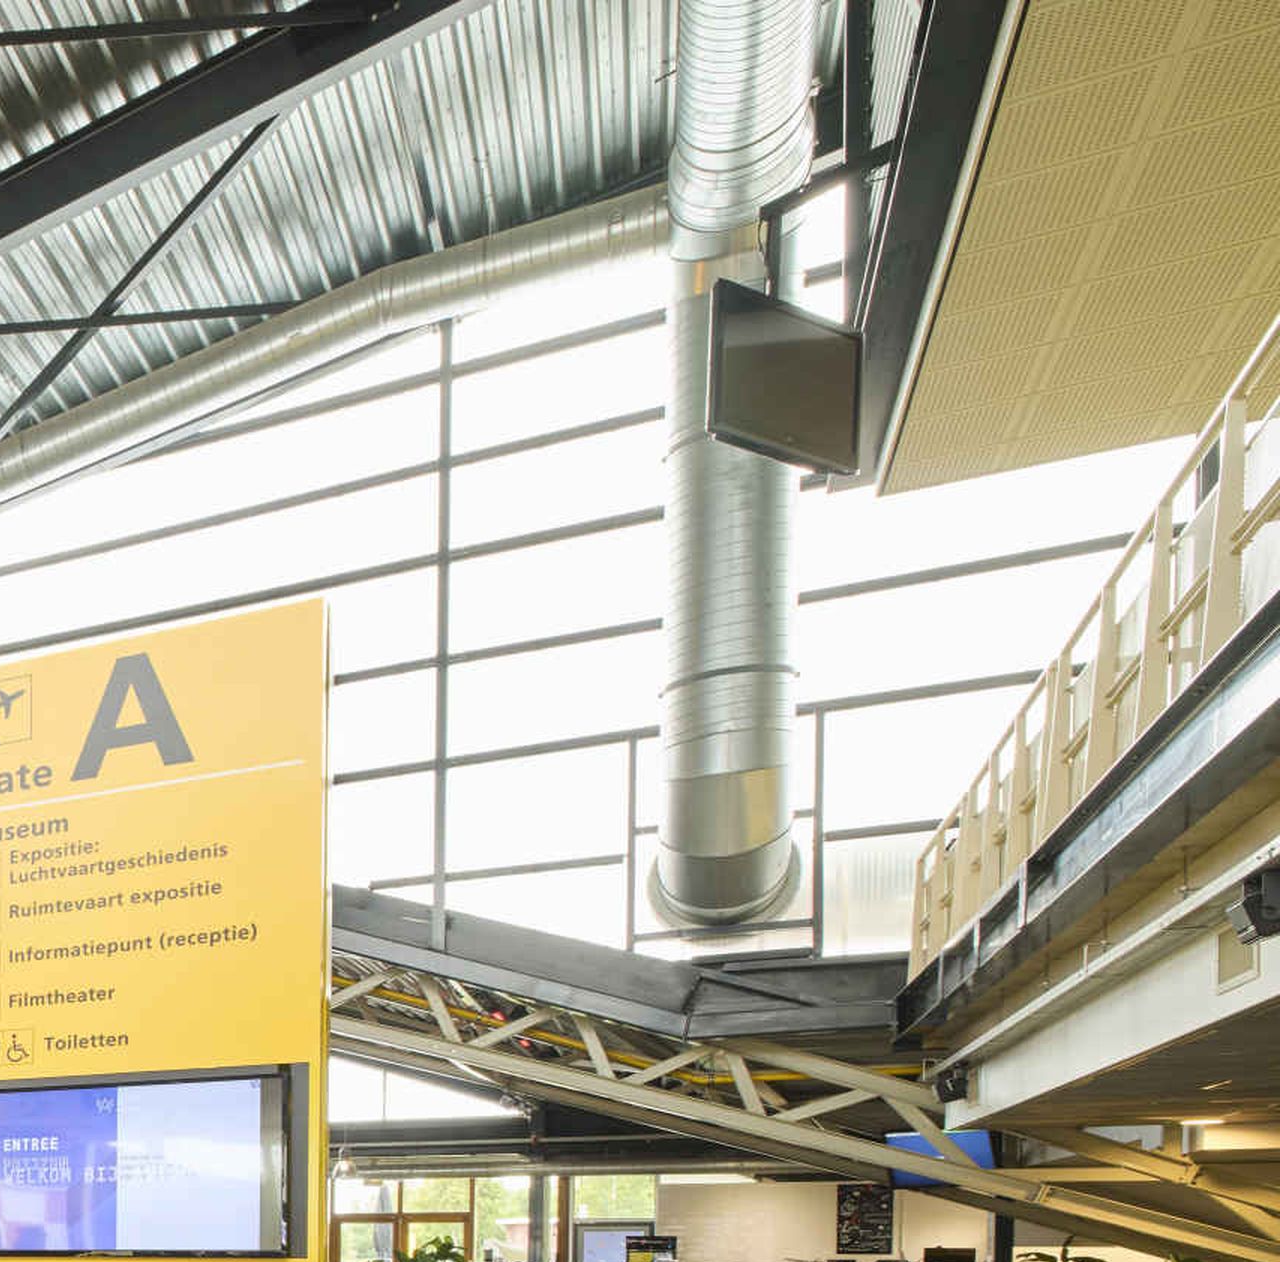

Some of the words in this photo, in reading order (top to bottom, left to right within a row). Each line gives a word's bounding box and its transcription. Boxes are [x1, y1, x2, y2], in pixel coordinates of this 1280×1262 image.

[70, 652, 195, 782] A
[9, 841, 100, 866] Expositie:
[9, 842, 228, 885] Luchtvaartgeschiedenis
[9, 892, 123, 919] Ruimtevaart
[130, 879, 222, 907] expositie
[9, 934, 153, 964] Informatiepunt
[159, 923, 258, 951] (receptie)
[8, 987, 115, 1009] Filmtheater
[44, 1032, 129, 1051] Toiletten
[3, 1136, 59, 1152] ENTREE
